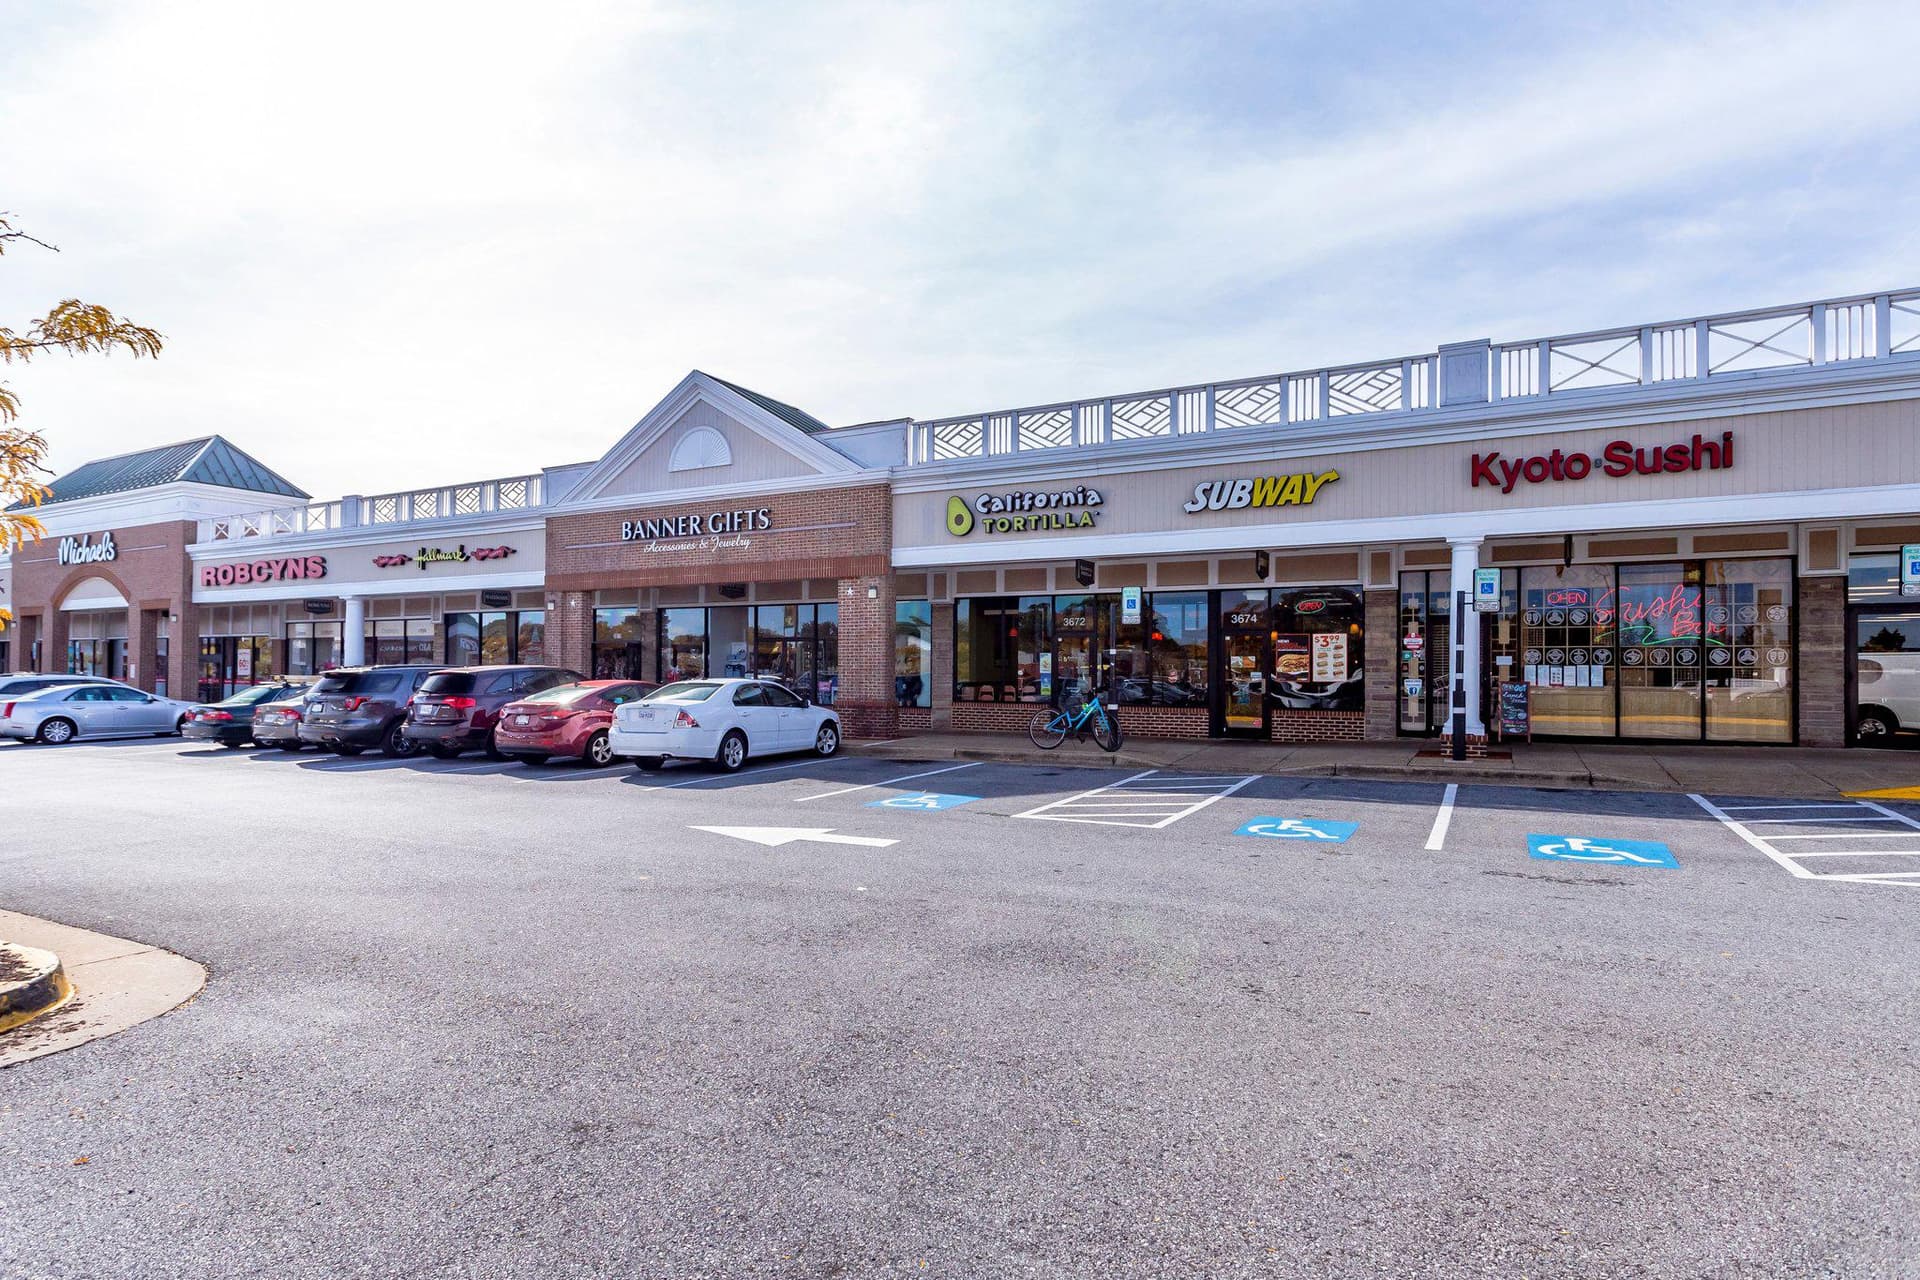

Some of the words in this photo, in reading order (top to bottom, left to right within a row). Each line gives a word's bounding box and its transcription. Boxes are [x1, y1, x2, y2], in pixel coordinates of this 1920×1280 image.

[1471, 449, 1591, 494] Kyoto
[1603, 431, 1734, 477] Sushi
[975, 486, 1103, 514] California
[1183, 469, 1340, 514] SUBWAY
[622, 515, 702, 541] BANNER
[708, 508, 772, 533] GIFTS
[982, 511, 1095, 534] TORTILLA
[57, 531, 117, 566] Michaels
[643, 540, 696, 553] Accessories
[699, 538, 708, 549] &
[711, 533, 750, 552] Jewelry
[201, 555, 328, 587] ROBCYNS
[1298, 601, 1323, 611] OPEN
[1548, 592, 1586, 604] OPEN
[1063, 617, 1086, 627] 3672
[1231, 614, 1257, 624] 3674
